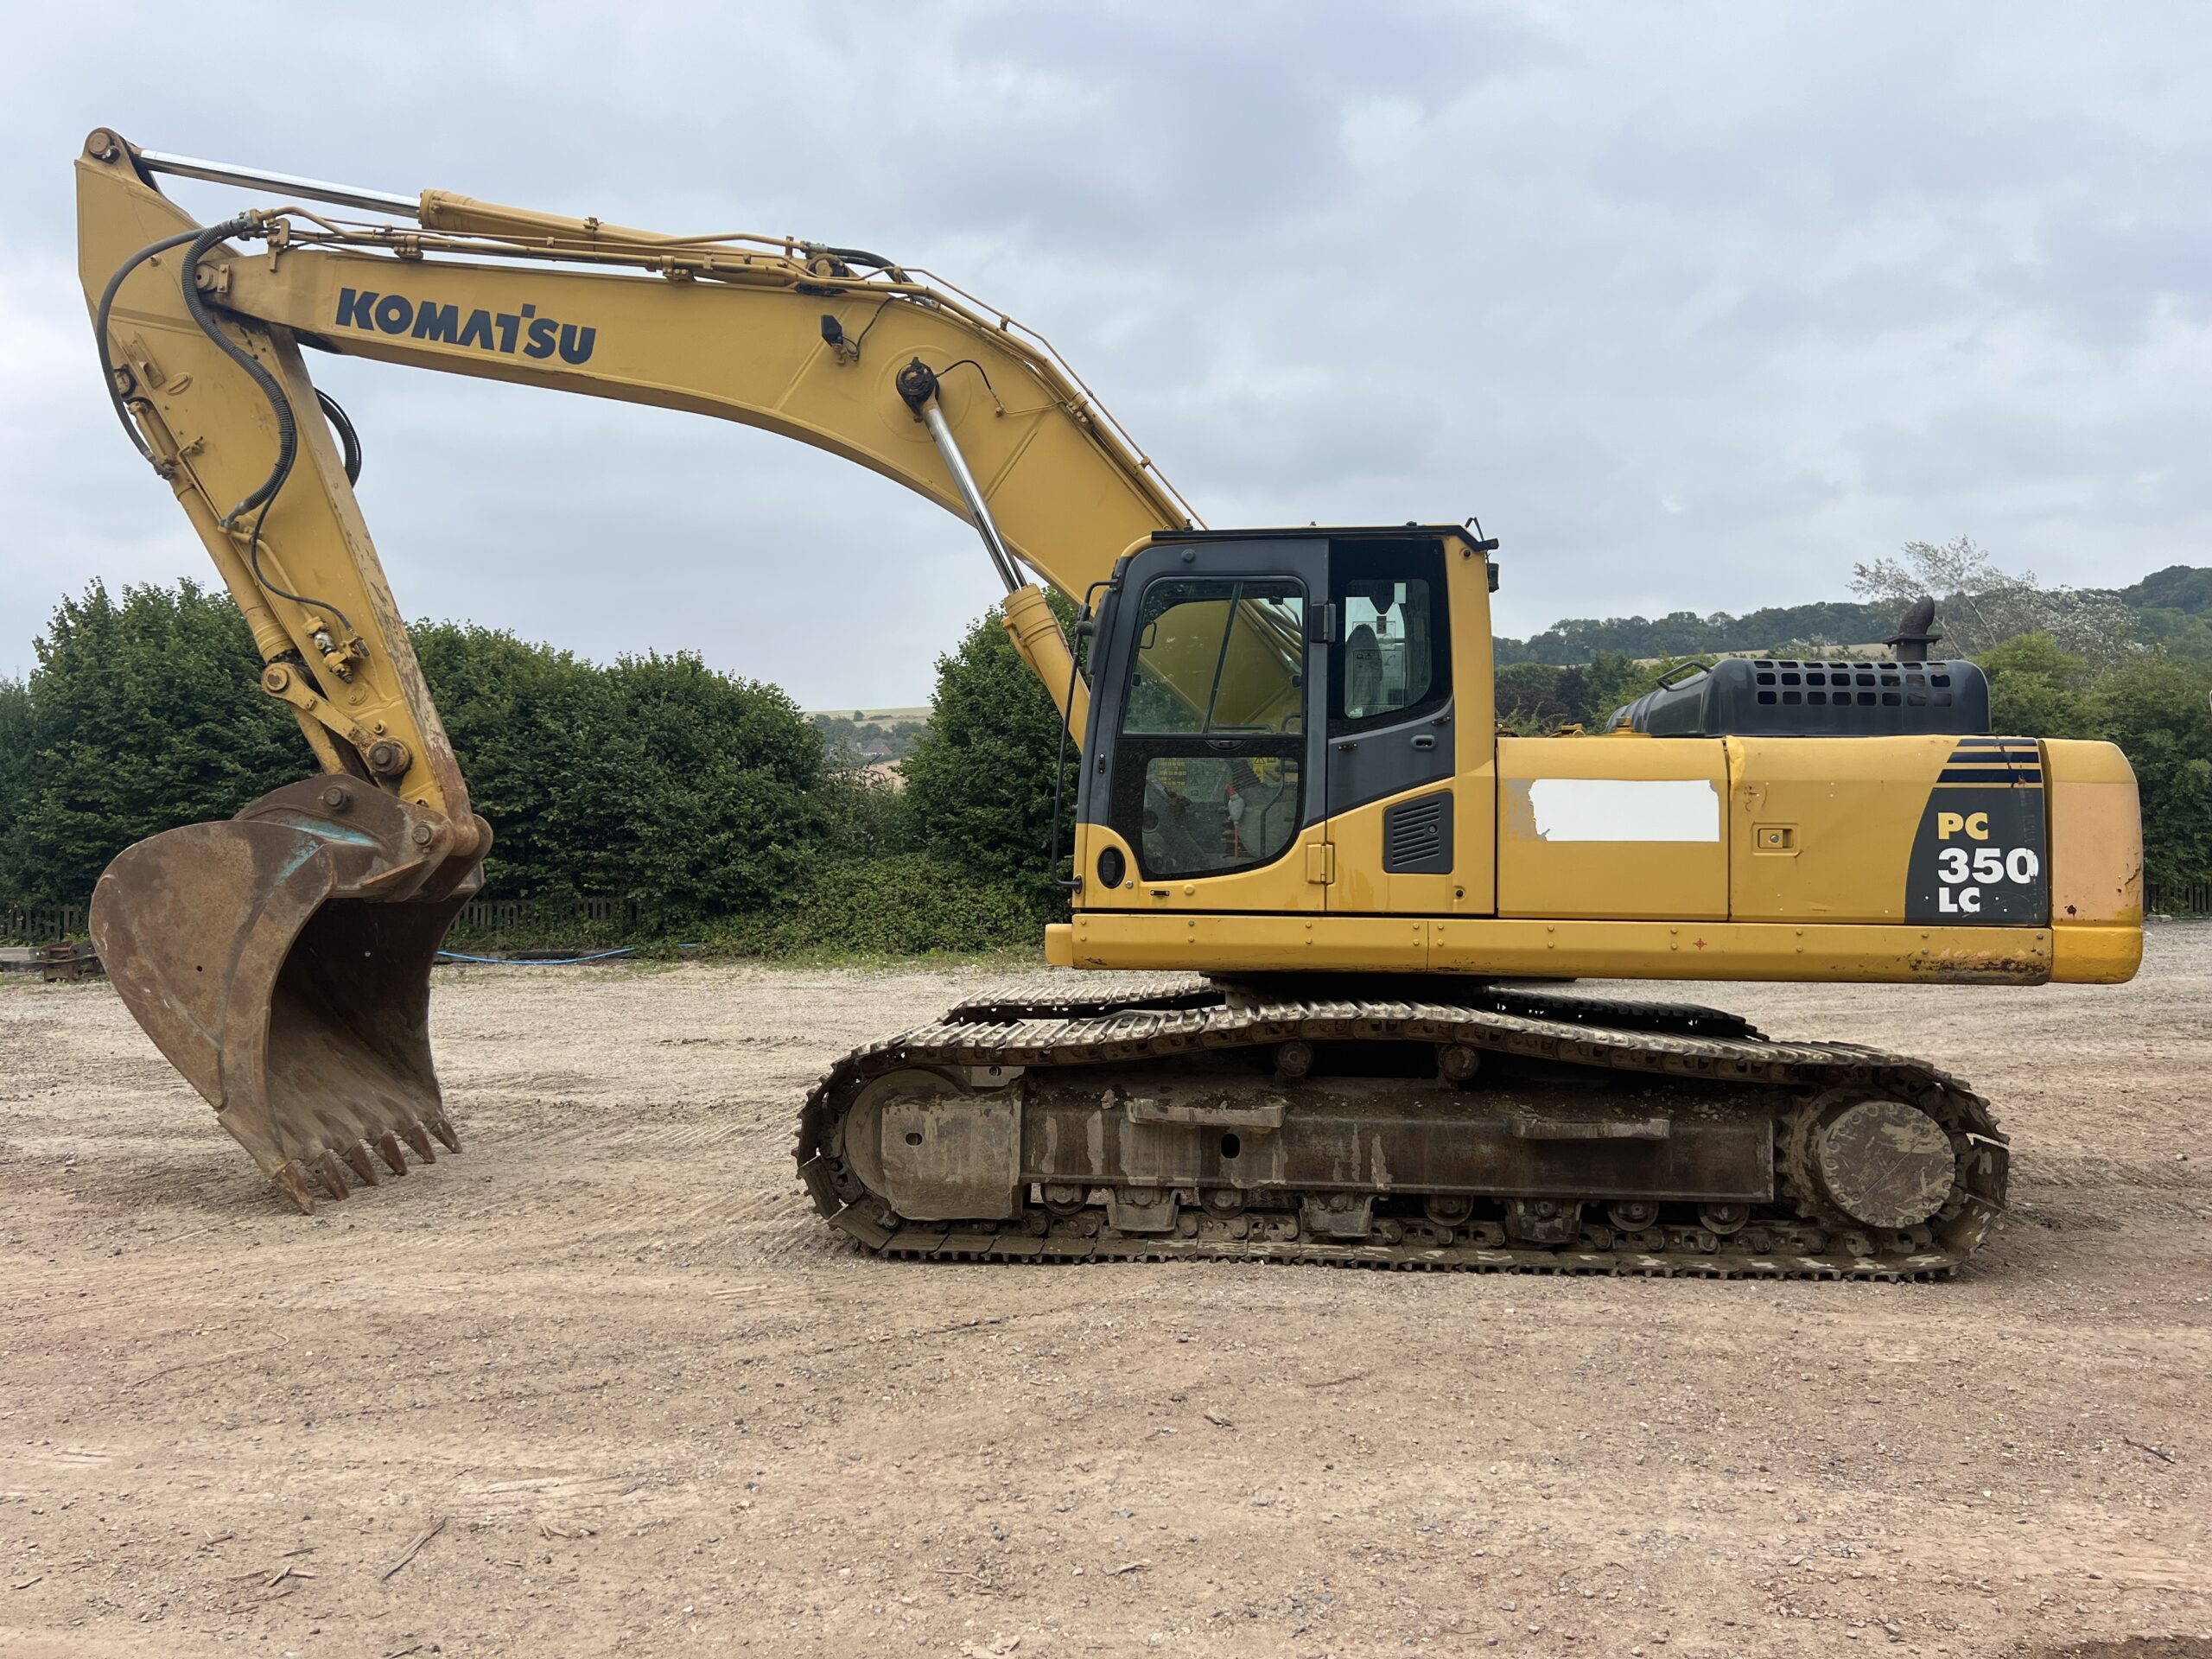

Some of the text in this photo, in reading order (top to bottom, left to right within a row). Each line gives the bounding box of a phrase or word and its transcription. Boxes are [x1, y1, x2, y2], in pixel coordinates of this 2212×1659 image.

[336, 287, 596, 365] KOMATSU
[1937, 812, 1989, 840] PC
[1937, 847, 2039, 884] 350
[1938, 887, 1980, 912] LC
